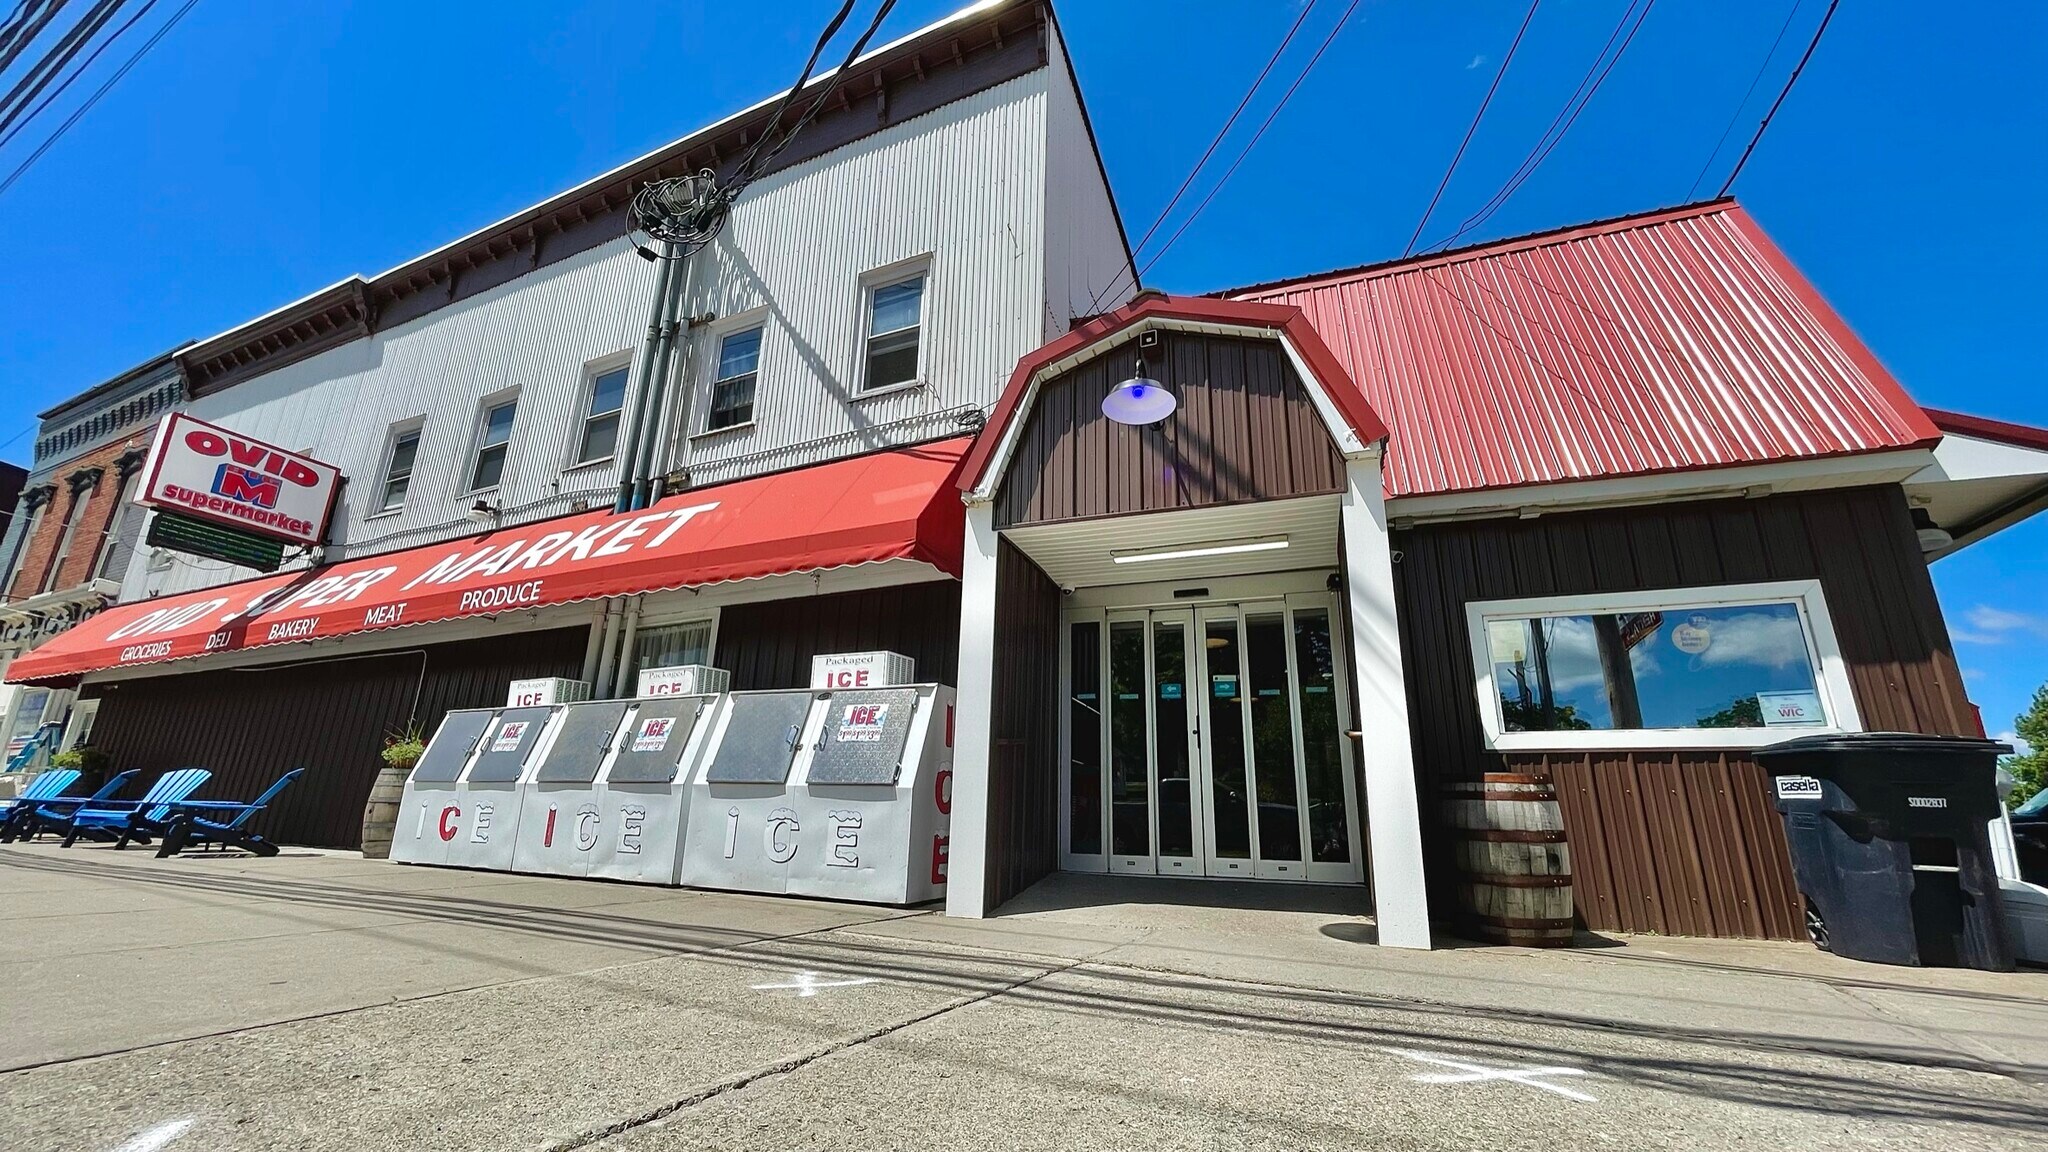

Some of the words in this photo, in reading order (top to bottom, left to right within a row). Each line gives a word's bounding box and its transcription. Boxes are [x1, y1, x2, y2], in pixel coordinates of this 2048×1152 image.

[185, 431, 319, 487] OVID
[211, 463, 283, 509] M
[163, 484, 313, 536] supermarket
[106, 598, 229, 642] OVID
[221, 566, 398, 622] SUPER
[400, 502, 721, 591] MARKET
[120, 641, 173, 662] GROCERIES
[205, 631, 232, 650] DELI
[268, 617, 320, 641] BAKERY
[364, 603, 407, 626] MEAT
[459, 580, 544, 611] PRODUCE
[826, 655, 873, 666] Packaged
[648, 669, 686, 679] Packaged
[827, 669, 869, 688] ICE
[517, 681, 547, 690] Packaged
[649, 682, 682, 695] ICE
[517, 692, 543, 707] ICE
[848, 705, 881, 726] ICE
[1777, 708, 1805, 717] WIC
[502, 723, 524, 739] ICE
[643, 719, 669, 737] ICE
[1780, 779, 1820, 792] casella
[415, 799, 495, 844] ICE
[544, 801, 646, 855] ICE
[724, 805, 863, 868] ICE
